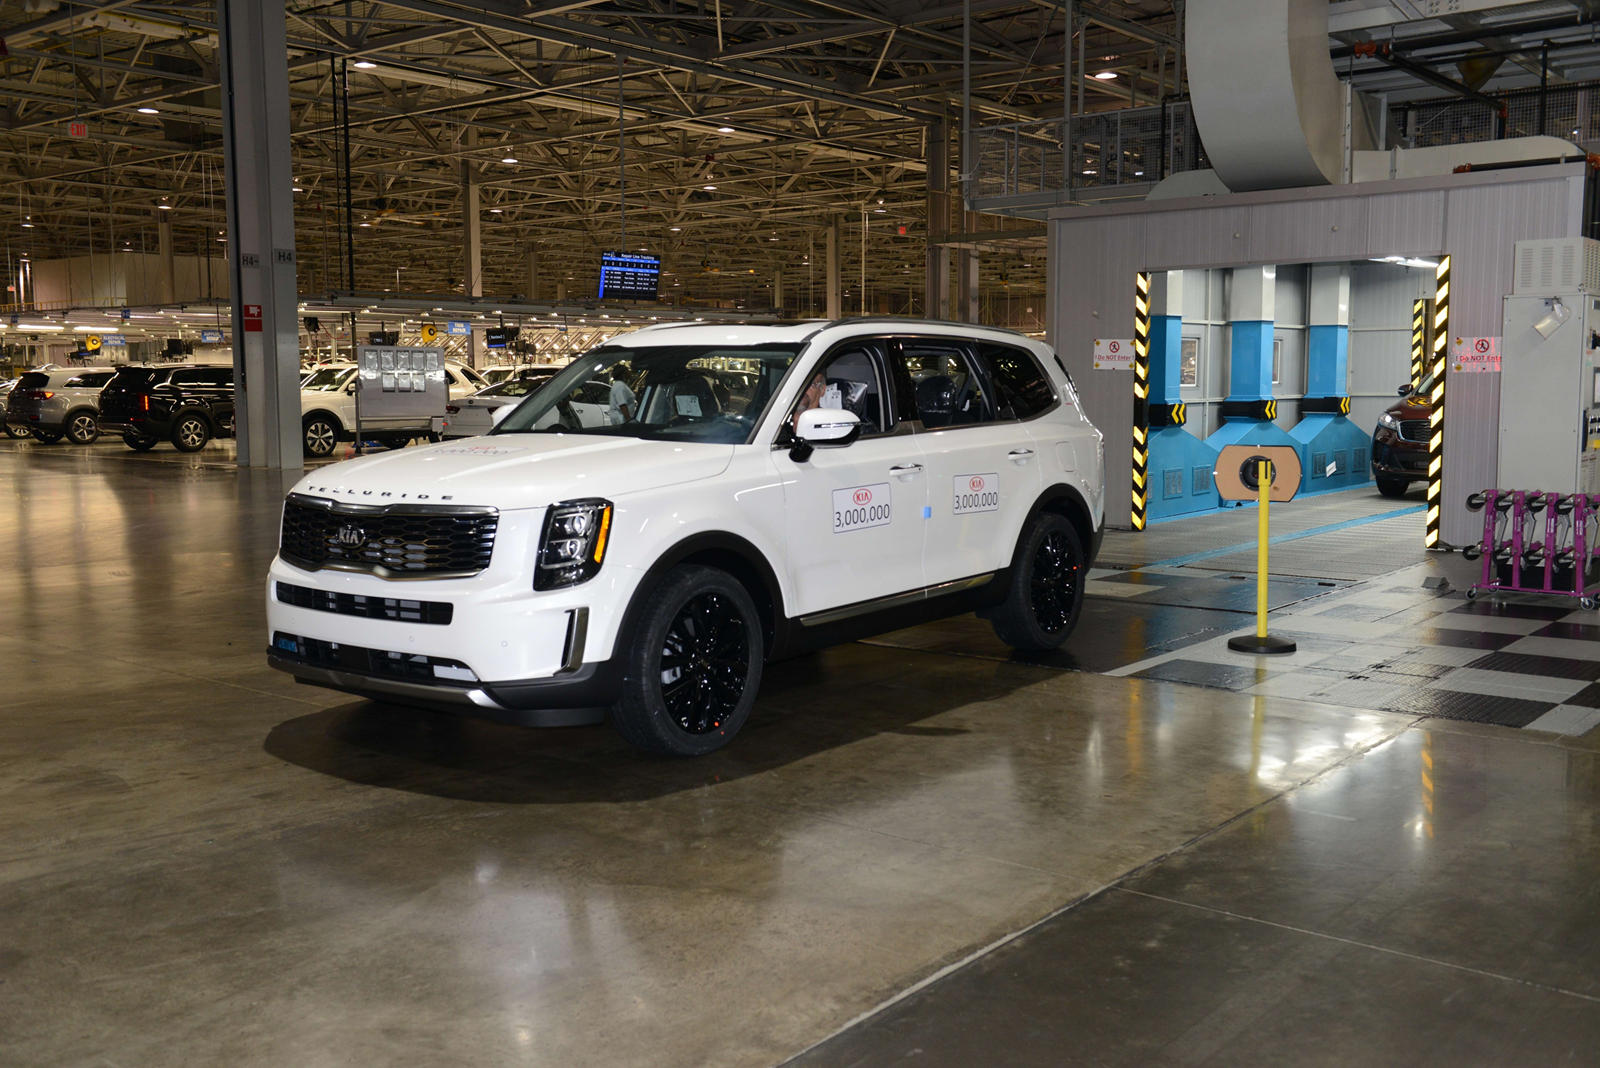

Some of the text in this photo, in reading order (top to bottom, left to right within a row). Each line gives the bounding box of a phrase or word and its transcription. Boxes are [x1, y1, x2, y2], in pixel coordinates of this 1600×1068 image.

[278, 252, 292, 261] H4
[307, 485, 454, 501] TELLURIDE
[954, 491, 998, 510] 3,000,000
[835, 503, 890, 528] 3,000,000
